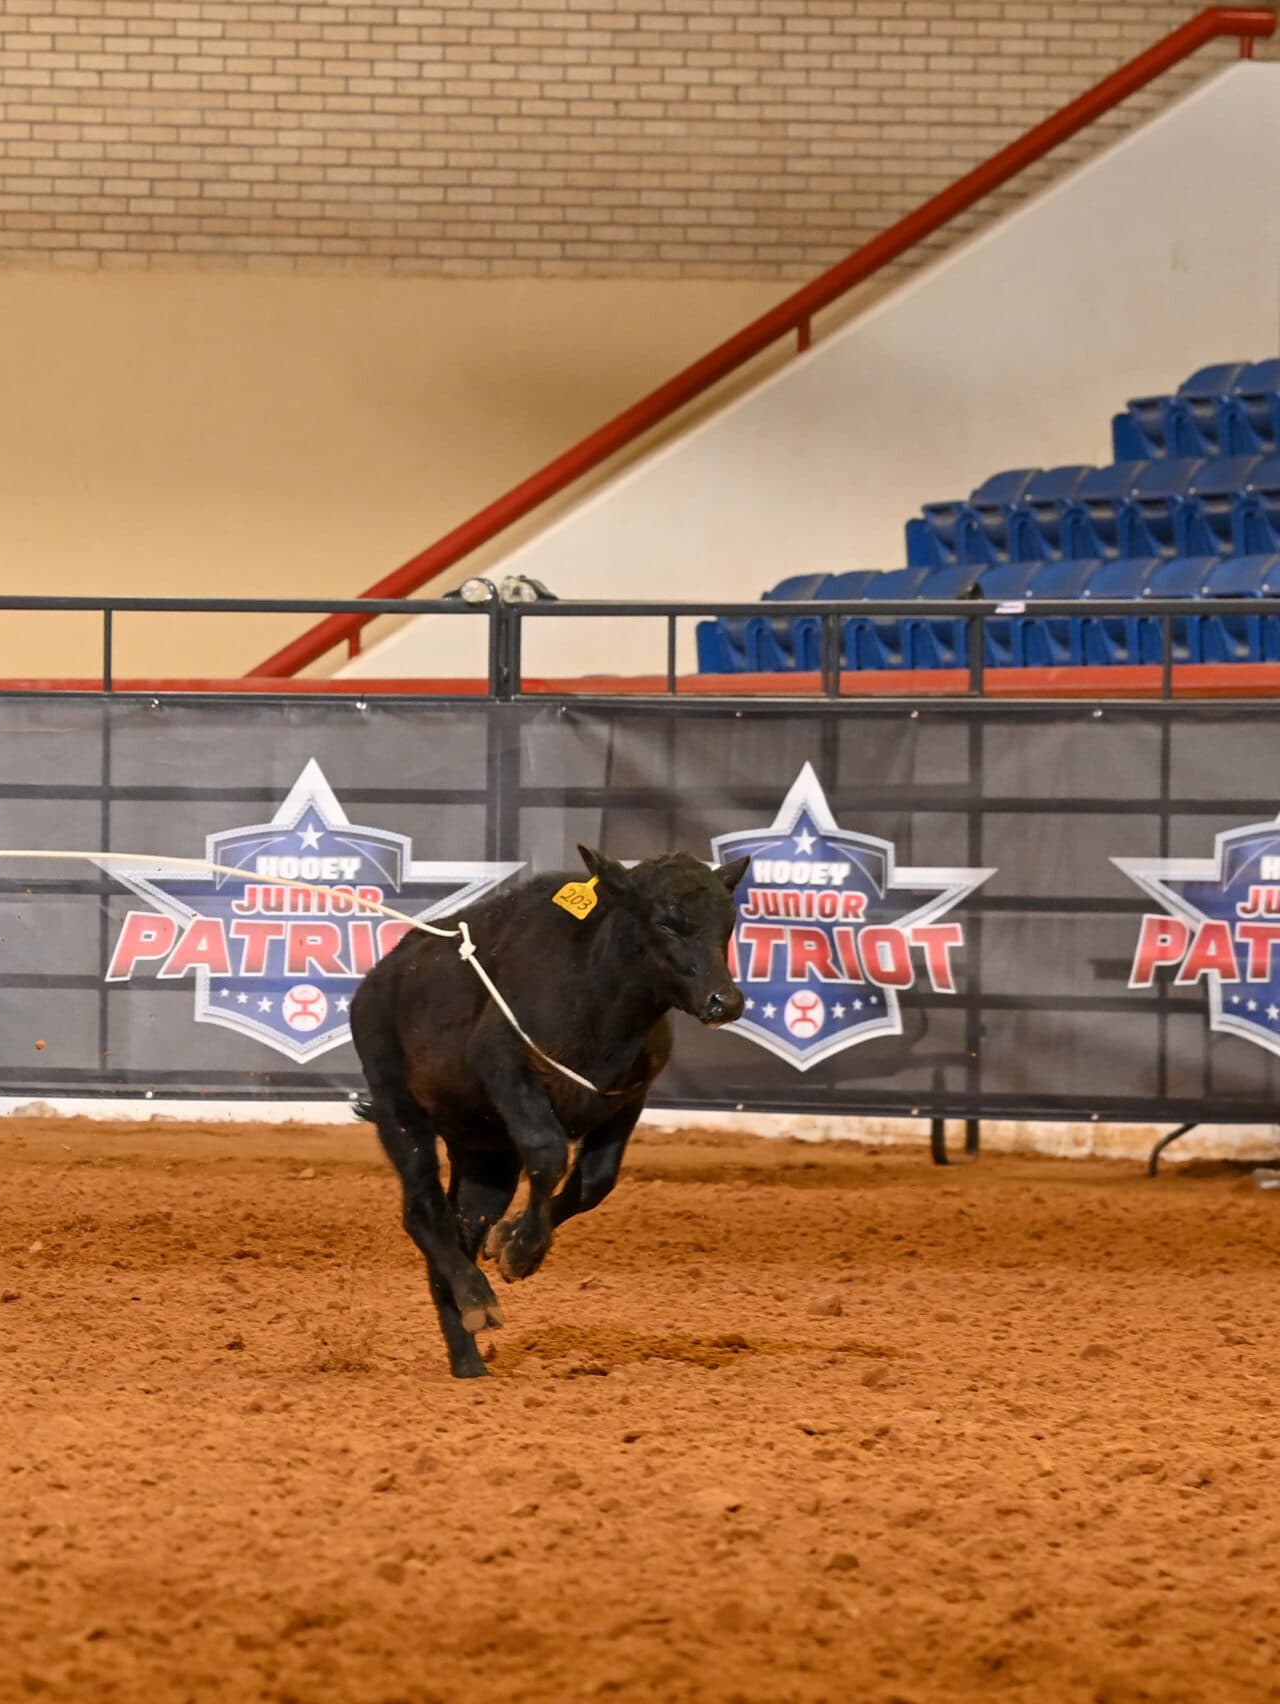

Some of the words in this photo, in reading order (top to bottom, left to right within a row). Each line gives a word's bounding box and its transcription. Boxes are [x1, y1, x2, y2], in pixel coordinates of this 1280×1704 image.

[256, 855, 361, 881] HOOEY
[751, 859, 852, 886] HOOEY
[232, 884, 384, 915] JUNIOR
[560, 888, 593, 910] 203
[740, 888, 868, 922] JUNIOR
[105, 910, 415, 982] PATRI
[728, 922, 963, 994] TRIOT
